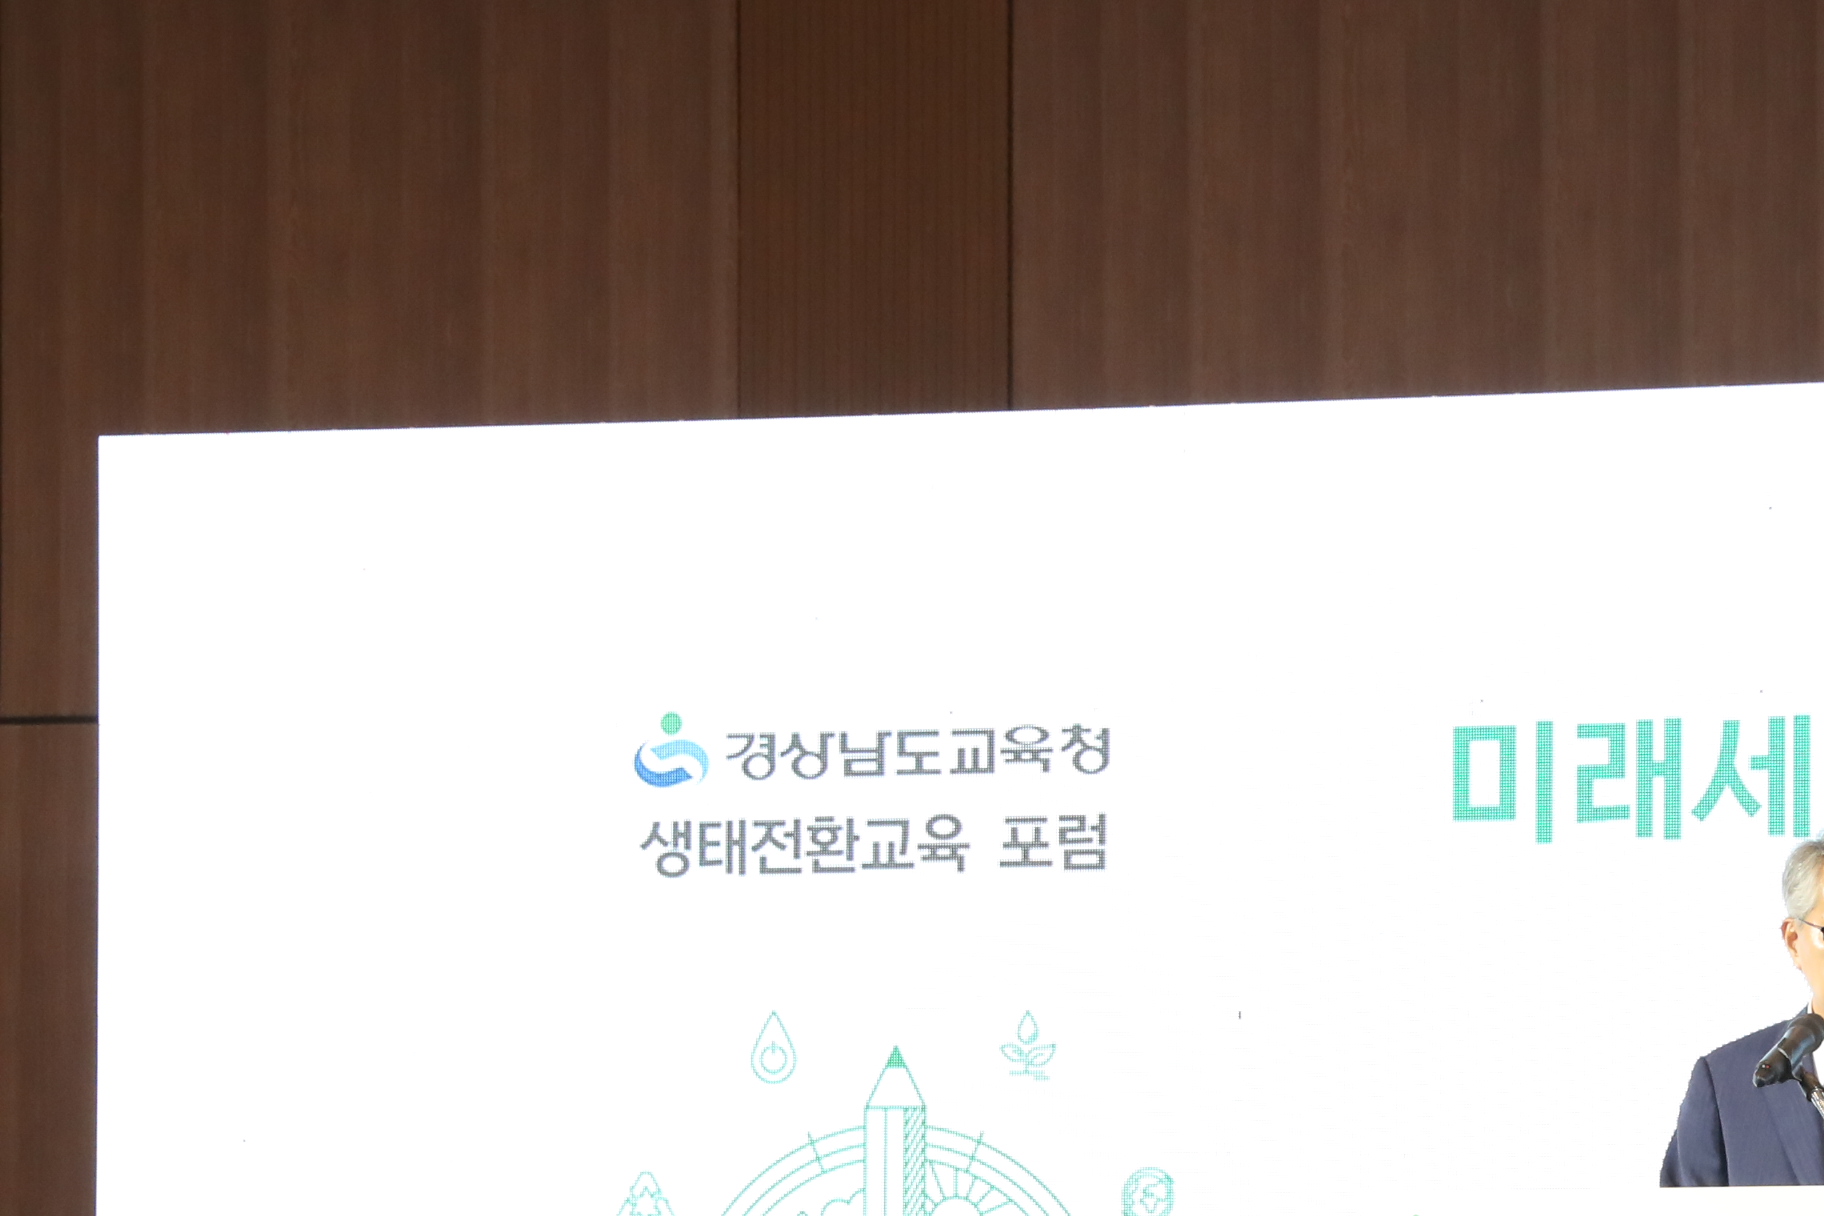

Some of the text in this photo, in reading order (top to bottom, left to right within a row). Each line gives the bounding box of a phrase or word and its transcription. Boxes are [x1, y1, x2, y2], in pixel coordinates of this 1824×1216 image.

[725, 723, 1111, 781] 경상남도교육청
[640, 813, 1107, 878] 생태전환교육 포럼
